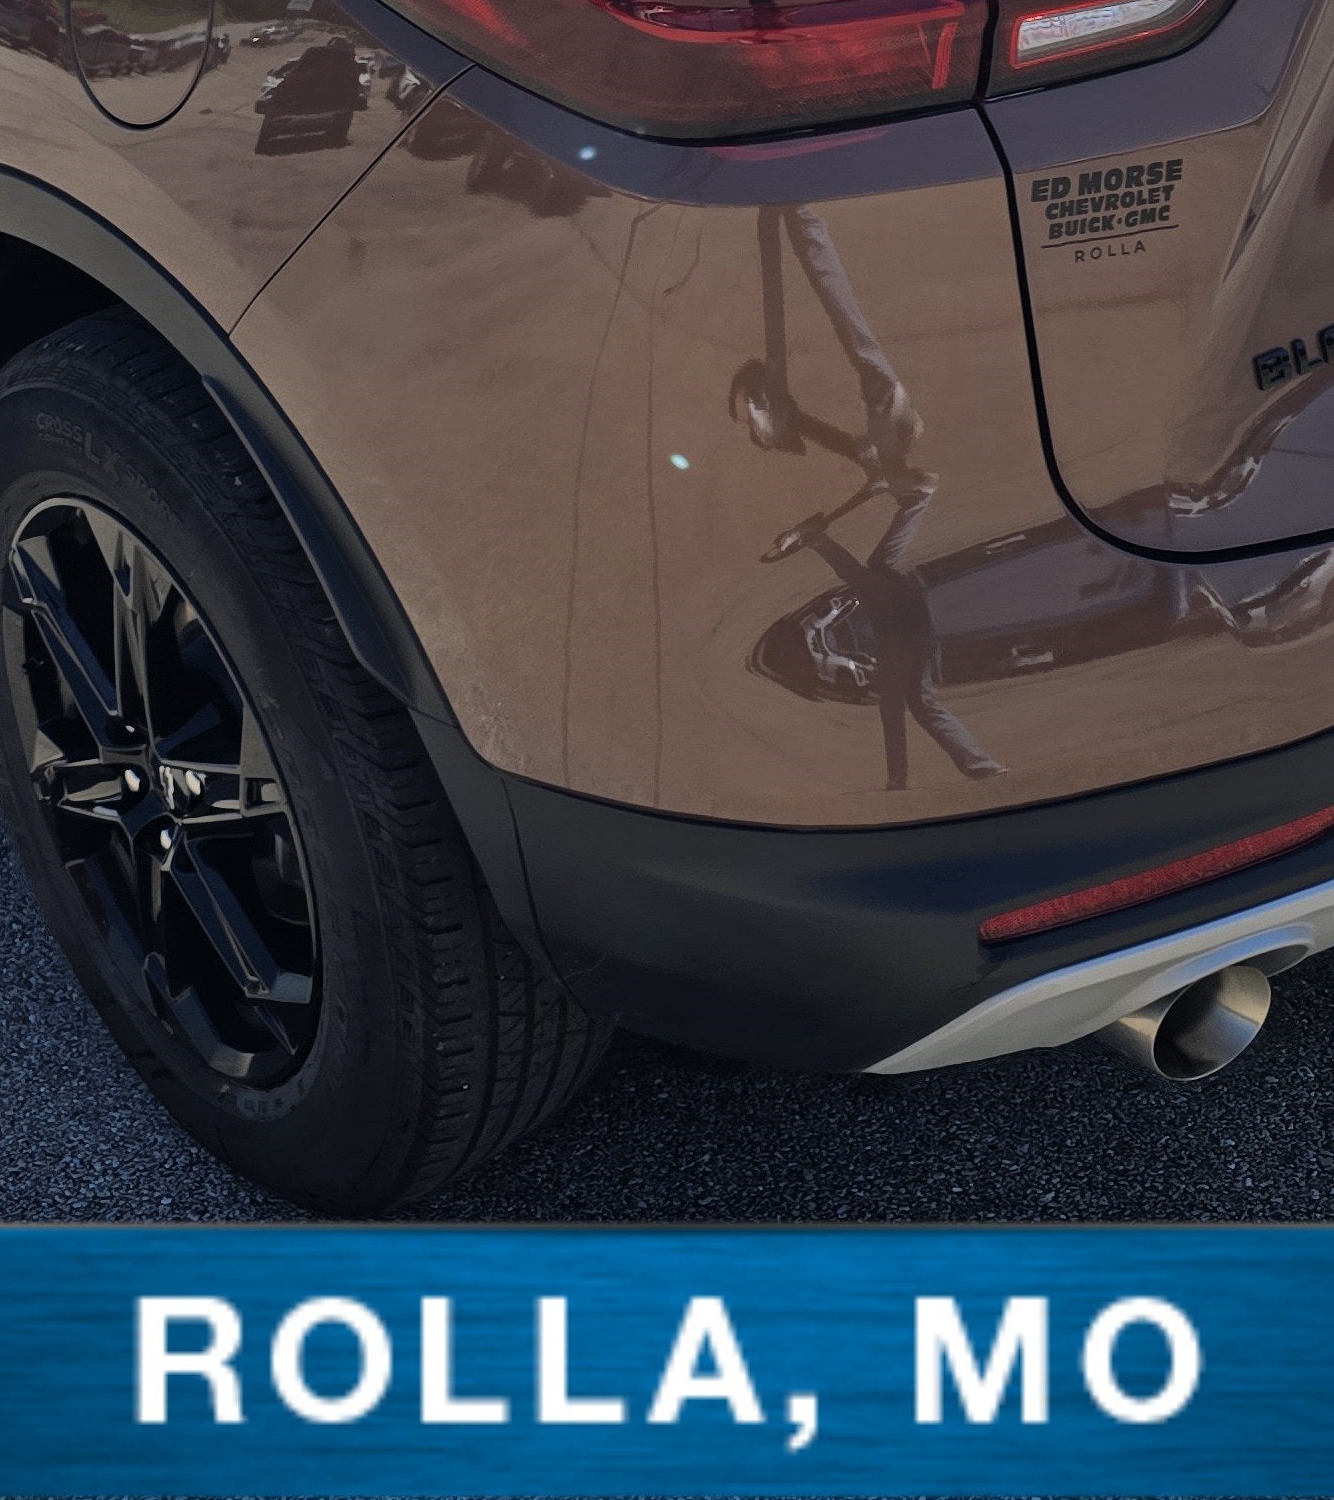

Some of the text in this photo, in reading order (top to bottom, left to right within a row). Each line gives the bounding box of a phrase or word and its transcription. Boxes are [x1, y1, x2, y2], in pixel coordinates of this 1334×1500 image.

[1029, 157, 1184, 203] ED MORSE
[1044, 183, 1176, 222] CHEVROLET
[1073, 240, 1147, 264] ROLLA
[35, 411, 84, 443] CROSS
